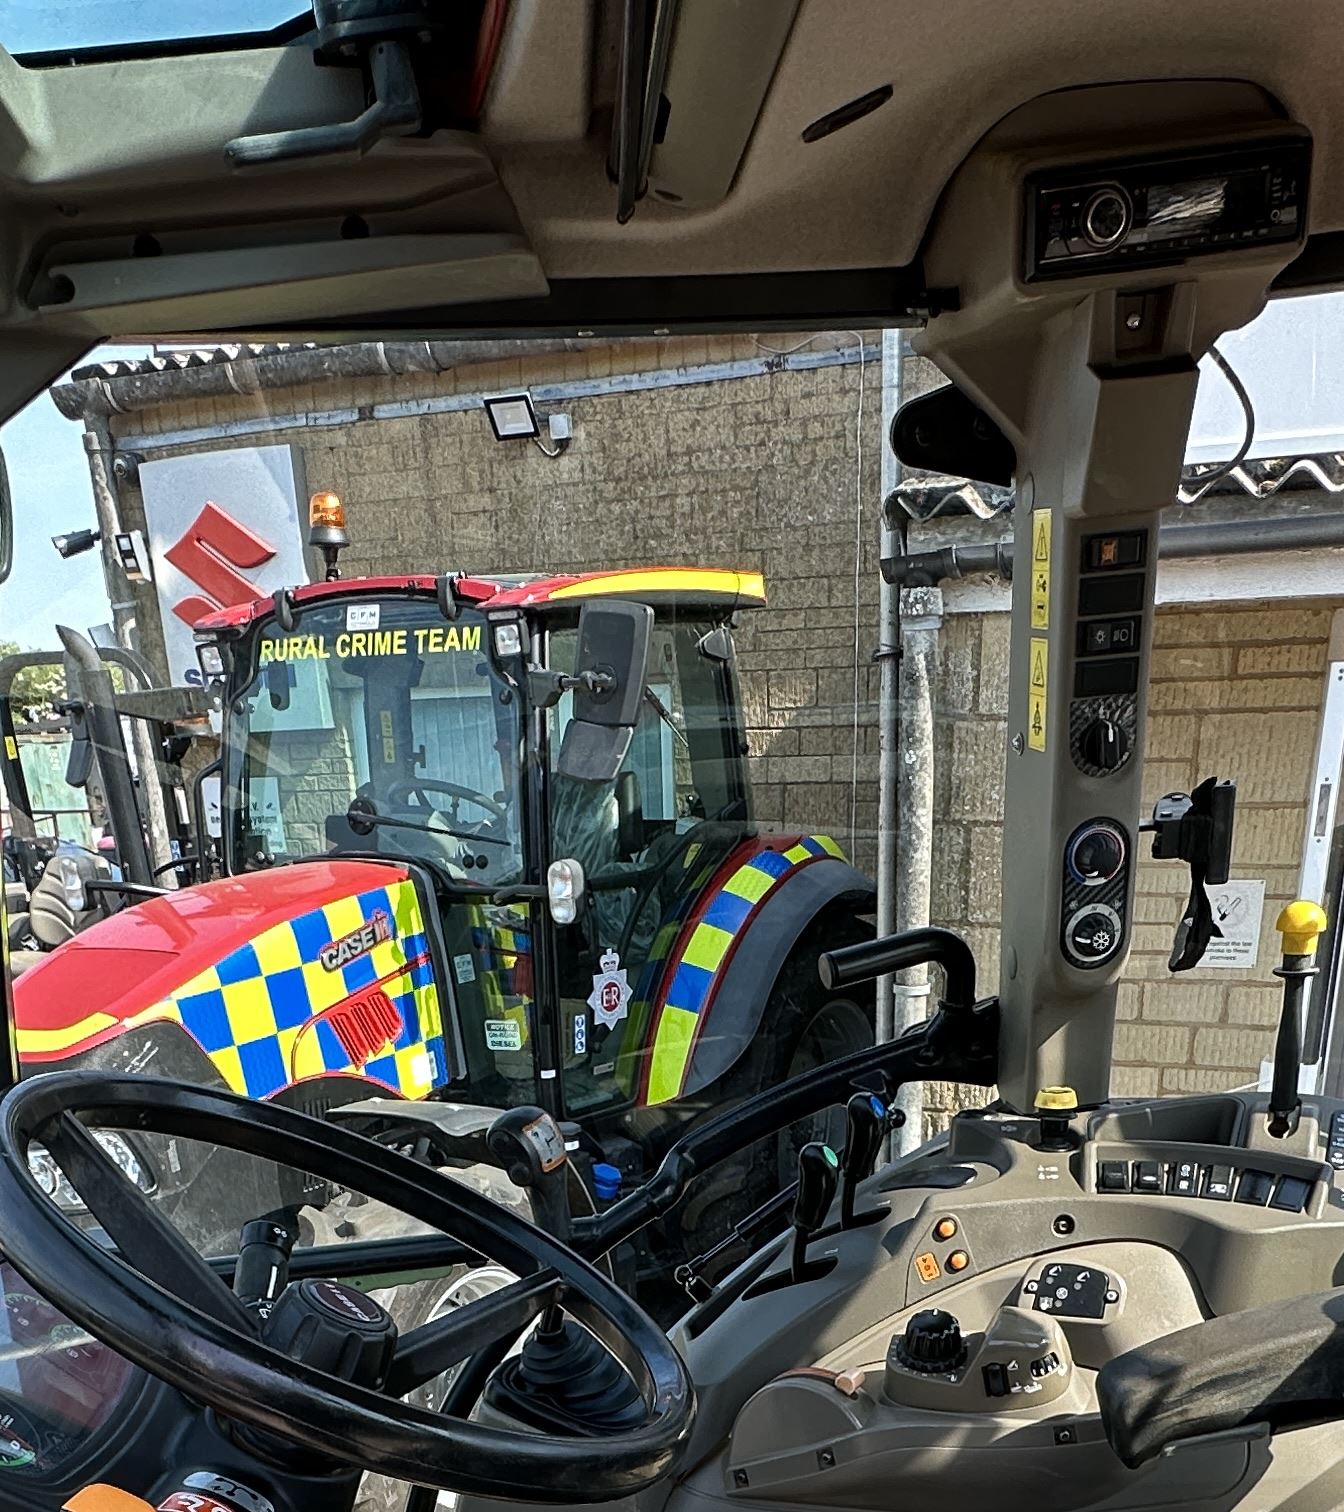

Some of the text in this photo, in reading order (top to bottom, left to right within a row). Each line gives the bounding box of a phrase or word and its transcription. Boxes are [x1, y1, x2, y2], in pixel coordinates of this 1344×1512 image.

[260, 626, 482, 662] RURAL CRIME TEAM
[321, 926, 375, 970] CASE
